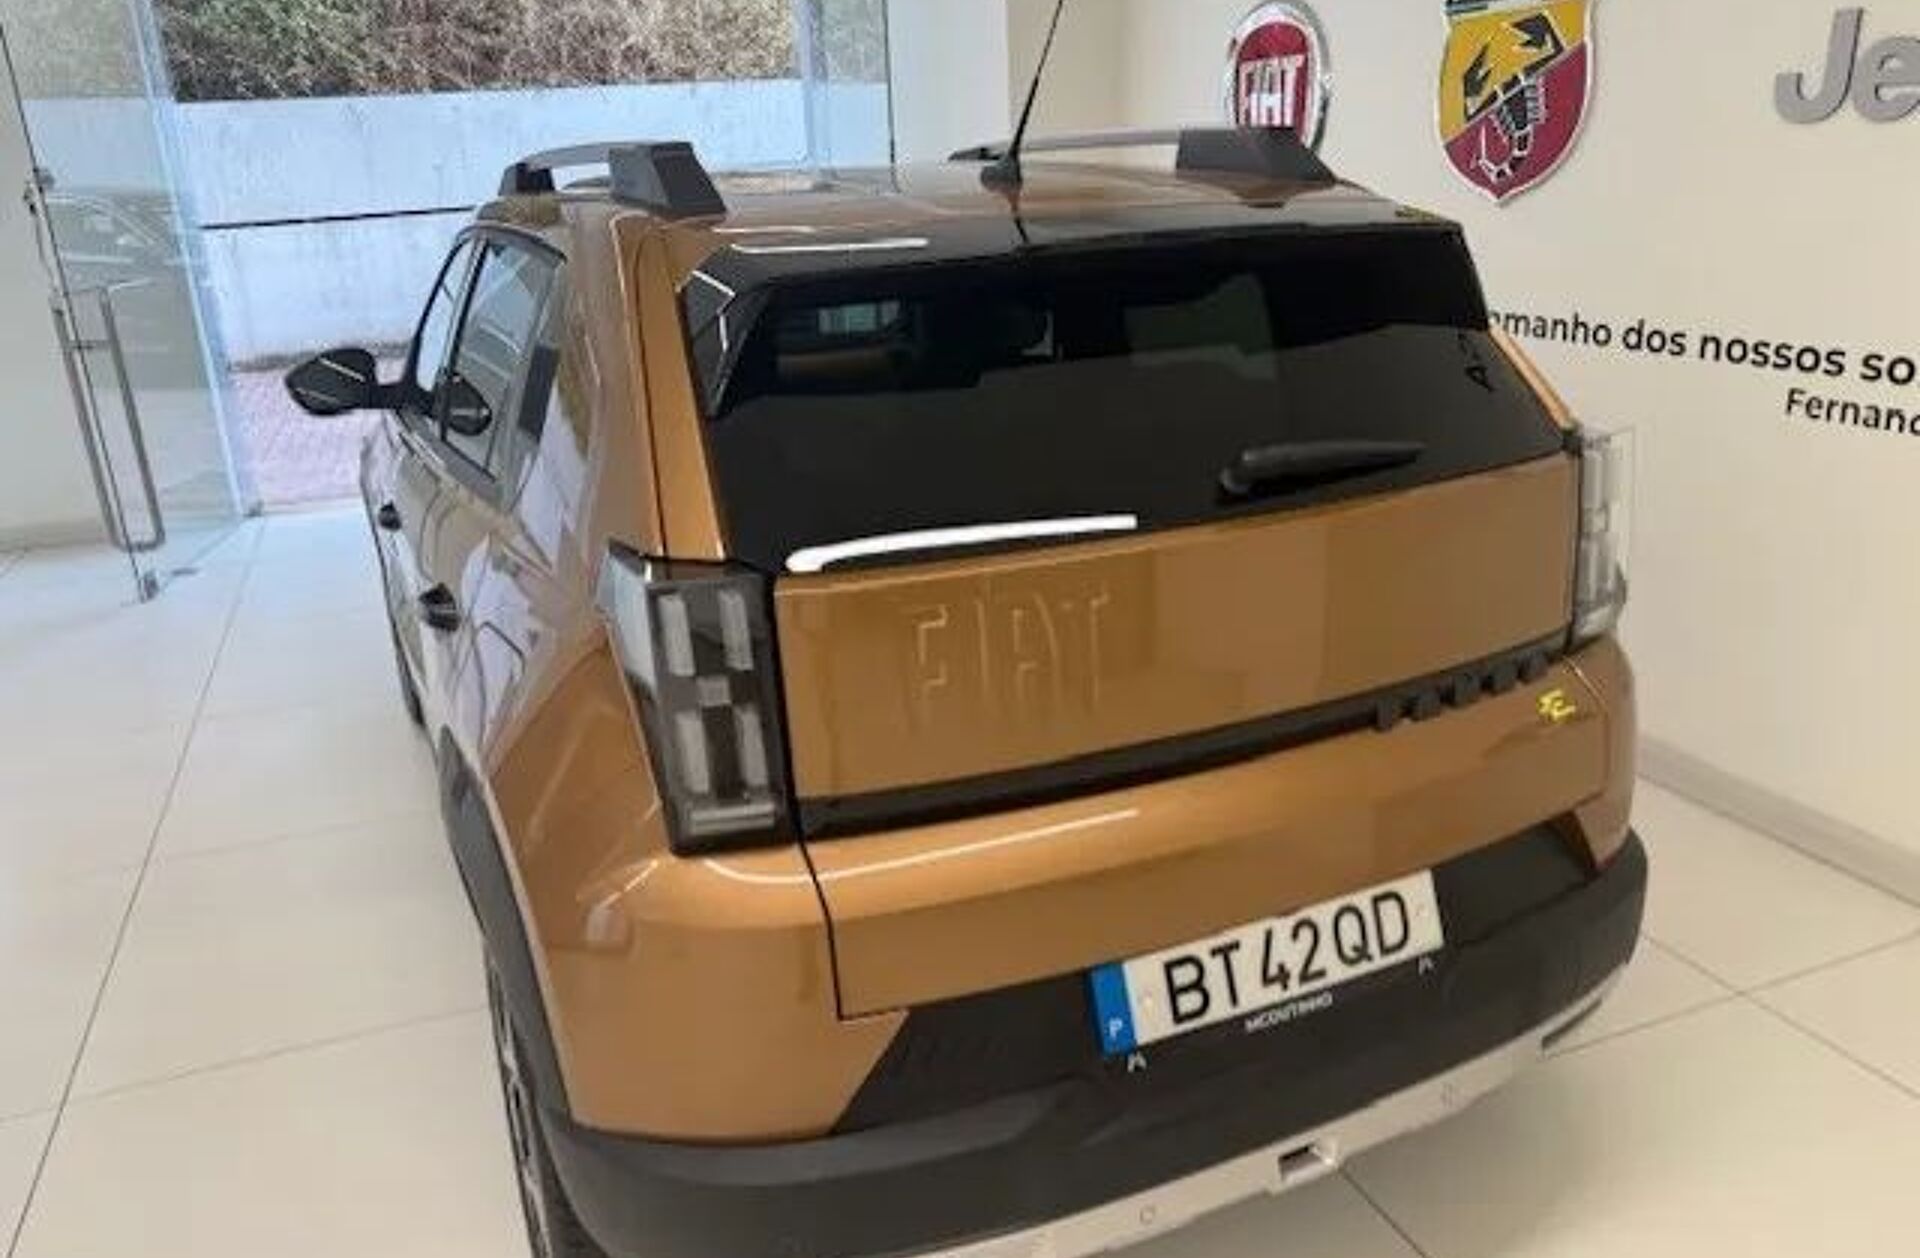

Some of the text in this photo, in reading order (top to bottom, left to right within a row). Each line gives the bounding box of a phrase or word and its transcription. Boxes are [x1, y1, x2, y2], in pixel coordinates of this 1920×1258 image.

[1239, 54, 1304, 128] FIAT
[1774, 8, 1920, 124] Je
[1622, 318, 1687, 356] dos
[1699, 334, 1846, 377] nossos
[903, 590, 1110, 731] FIAT
[1163, 889, 1410, 1026] BT 42 QD
